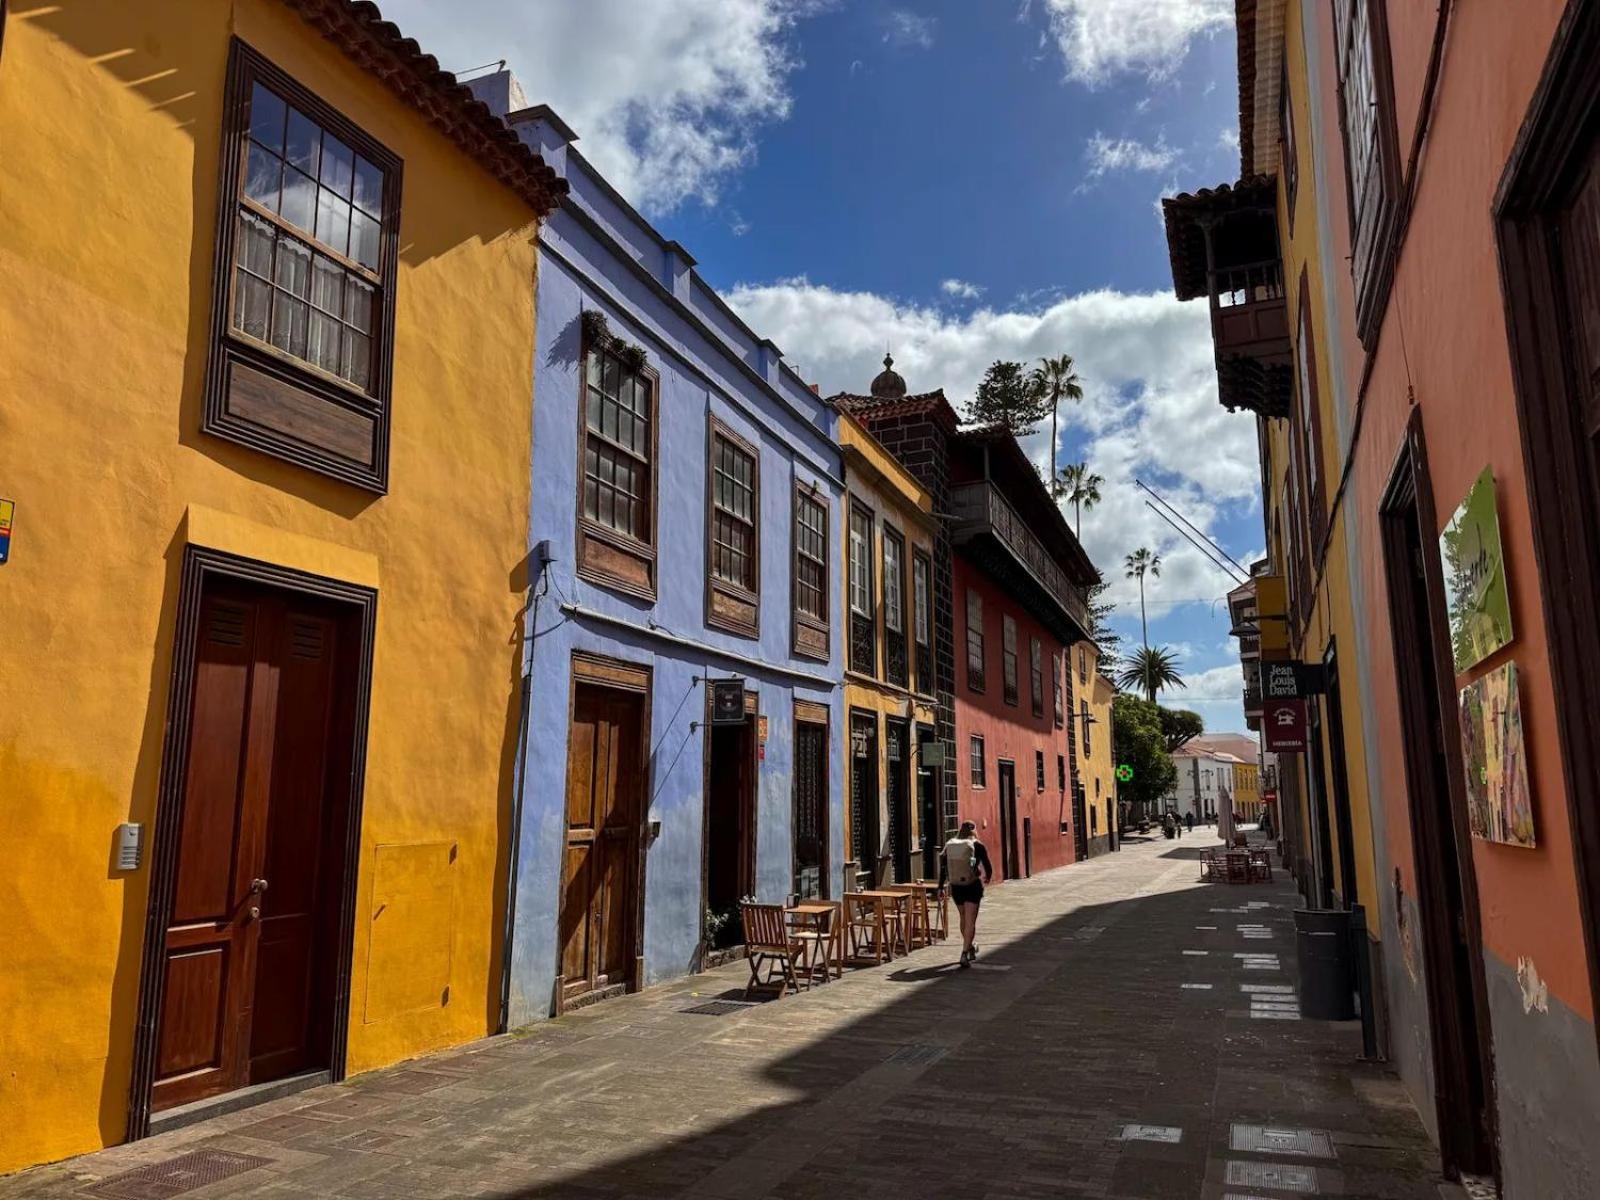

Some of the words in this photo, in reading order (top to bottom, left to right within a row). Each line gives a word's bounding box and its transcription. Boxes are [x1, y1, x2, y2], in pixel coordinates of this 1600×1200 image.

[1270, 664, 1293, 675] Jean
[1269, 675, 1296, 685] Louis
[1269, 684, 1297, 695] David
